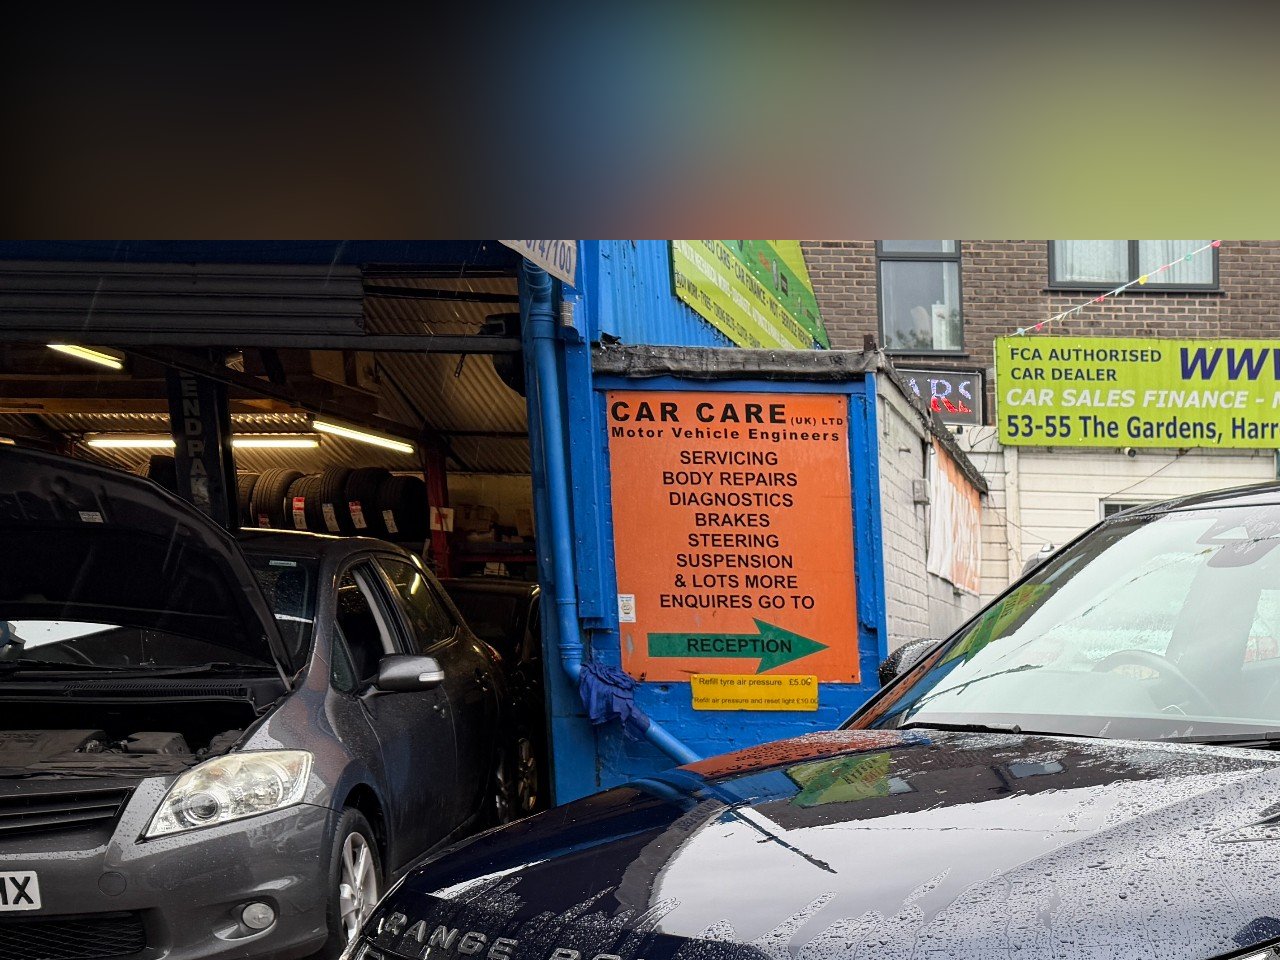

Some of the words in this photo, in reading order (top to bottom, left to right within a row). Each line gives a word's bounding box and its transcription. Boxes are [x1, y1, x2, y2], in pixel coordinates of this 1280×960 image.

[1010, 348, 1042, 361] FCA
[1048, 348, 1162, 363] AUTHORISED
[1011, 368, 1045, 381] CAR
[1051, 368, 1117, 382] DEALER
[1006, 389, 1053, 407] CAR
[1057, 389, 1135, 408] SALES
[1142, 390, 1247, 409] FINANCE
[611, 402, 679, 422] CAR
[696, 403, 787, 424] CARE
[790, 416, 817, 427] (UK)
[822, 418, 843, 426] LTD
[611, 426, 664, 438] Motor
[672, 427, 740, 440] Vehicle
[748, 429, 840, 442] Engineers
[1007, 415, 1072, 438] 53-55
[1079, 416, 1119, 439] The
[1126, 416, 1223, 444] Gardens,
[680, 450, 778, 466] SERVICING
[663, 471, 714, 486] BODY
[719, 472, 798, 487] REPAIRS
[669, 492, 794, 507] DIAGNOSTICS
[695, 513, 770, 527] BRAKES
[688, 533, 779, 548] STEERING
[676, 554, 793, 568] SUSPENSION
[674, 574, 687, 588] &
[692, 574, 739, 588] LOTS
[745, 575, 797, 589] MORE
[660, 594, 752, 609] ENQUIRES
[758, 595, 786, 609] GO
[791, 596, 815, 609] TO
[687, 638, 792, 653] RECEPTION
[699, 678, 718, 686] Refill
[720, 679, 734, 687] tyre
